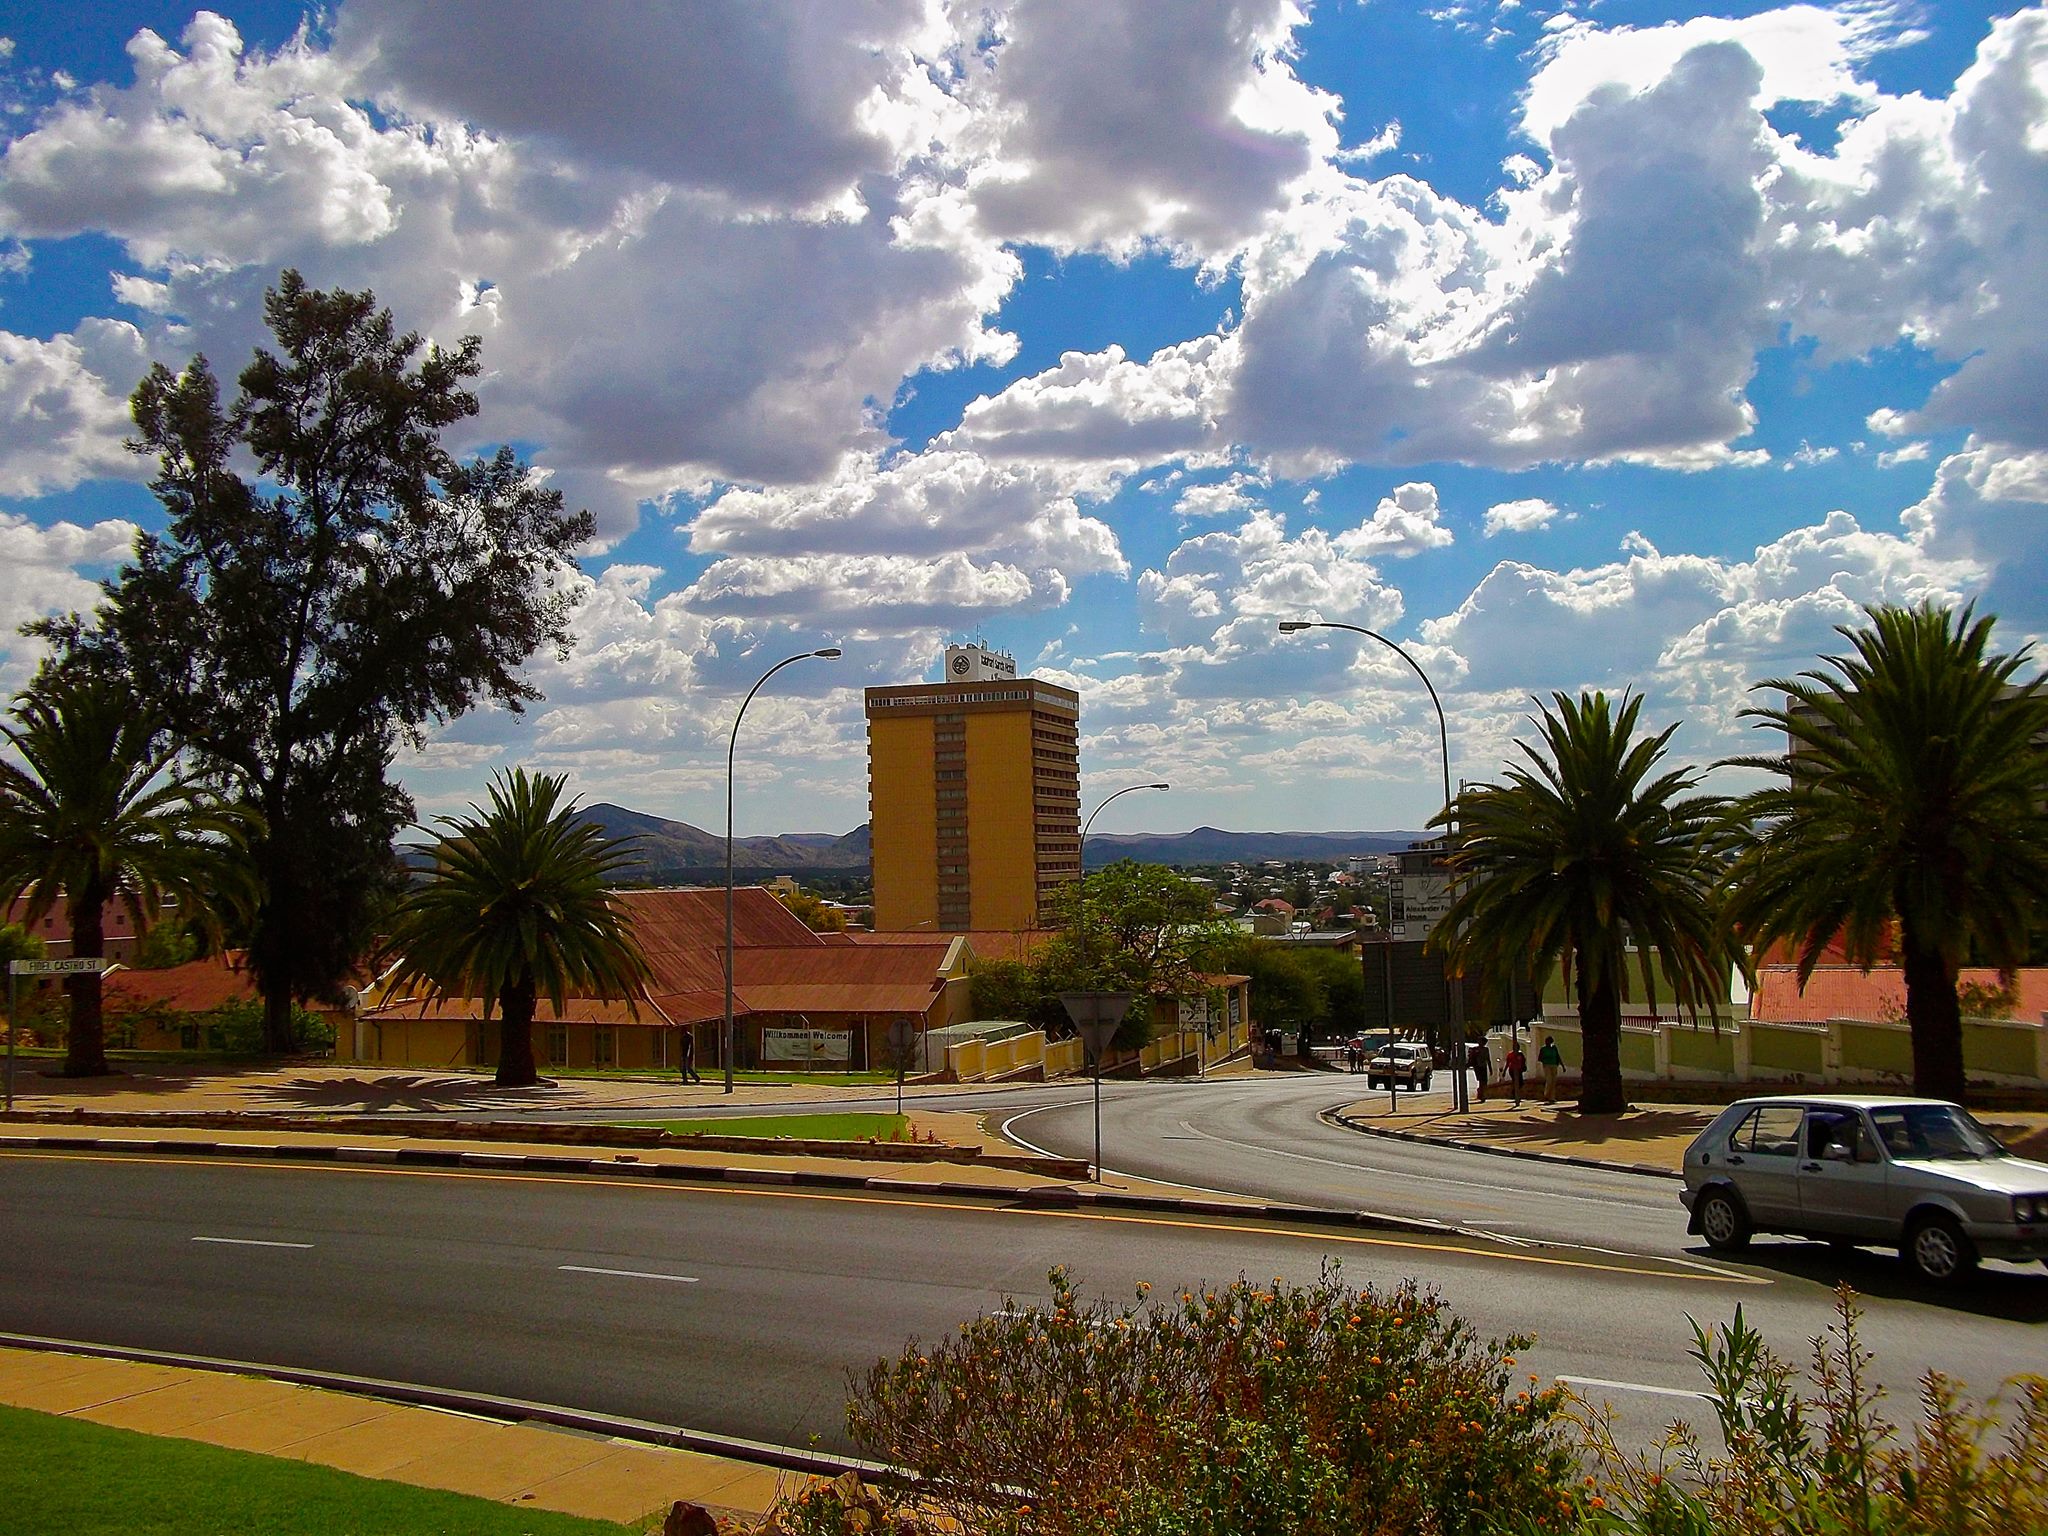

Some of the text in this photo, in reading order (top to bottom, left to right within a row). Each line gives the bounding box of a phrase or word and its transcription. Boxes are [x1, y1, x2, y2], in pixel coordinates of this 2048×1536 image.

[29, 960, 96, 971] FIDEL CASTRO ST
